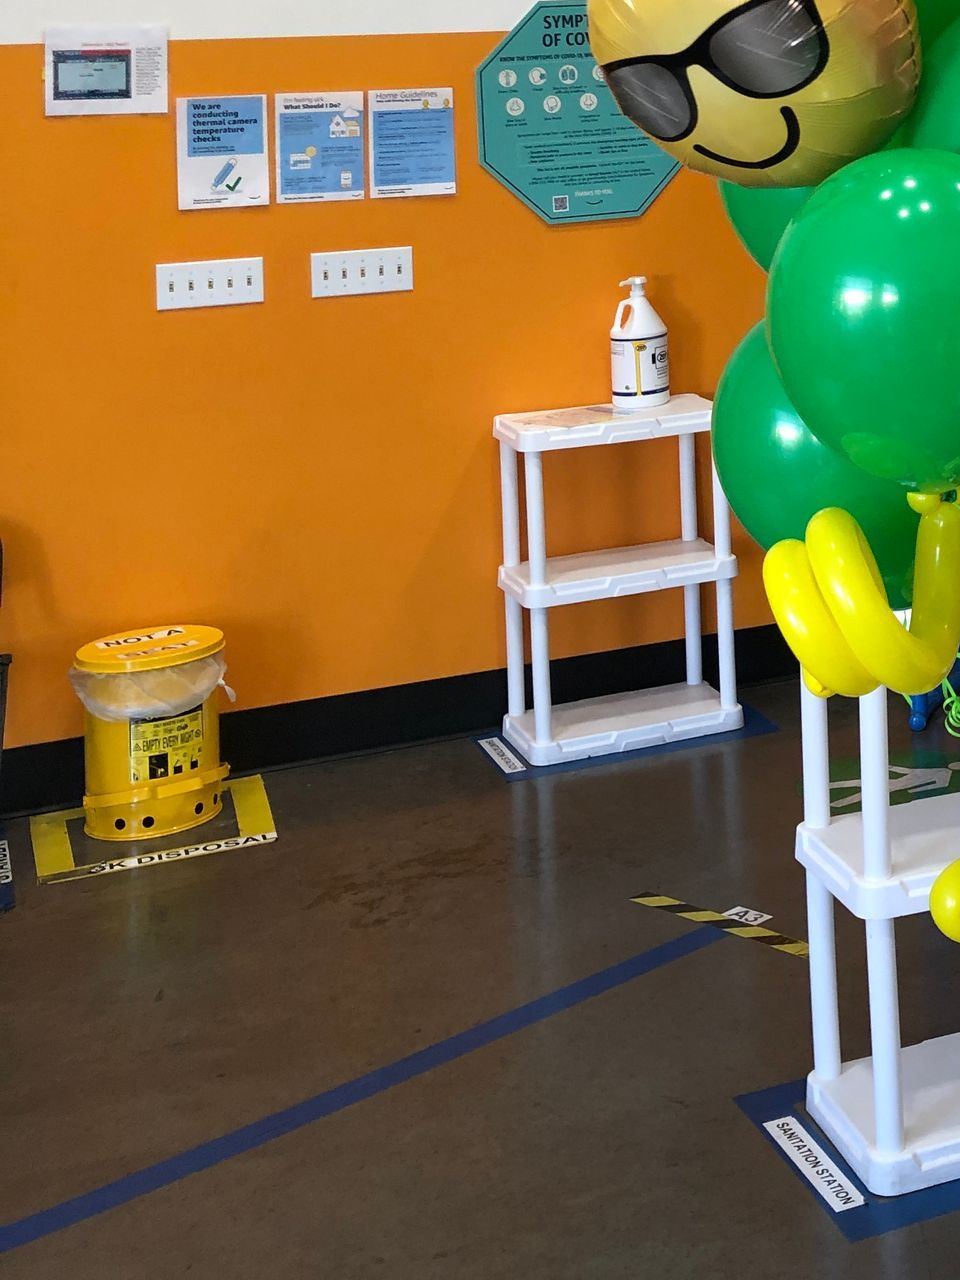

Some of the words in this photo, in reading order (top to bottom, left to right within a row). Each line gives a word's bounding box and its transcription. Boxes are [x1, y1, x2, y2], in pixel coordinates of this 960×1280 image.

[543, 14, 589, 30] SYMPT
[542, 33, 562, 47] OF
[193, 111, 239, 119] conducting
[228, 118, 258, 126] camera
[193, 127, 245, 136] temperature
[104, 635, 154, 648] NOT
[137, 833, 279, 865] DISPOSAL
[728, 910, 764, 923] A3
[776, 1121, 822, 1169] SANITATION
[815, 1168, 856, 1206] STATION
